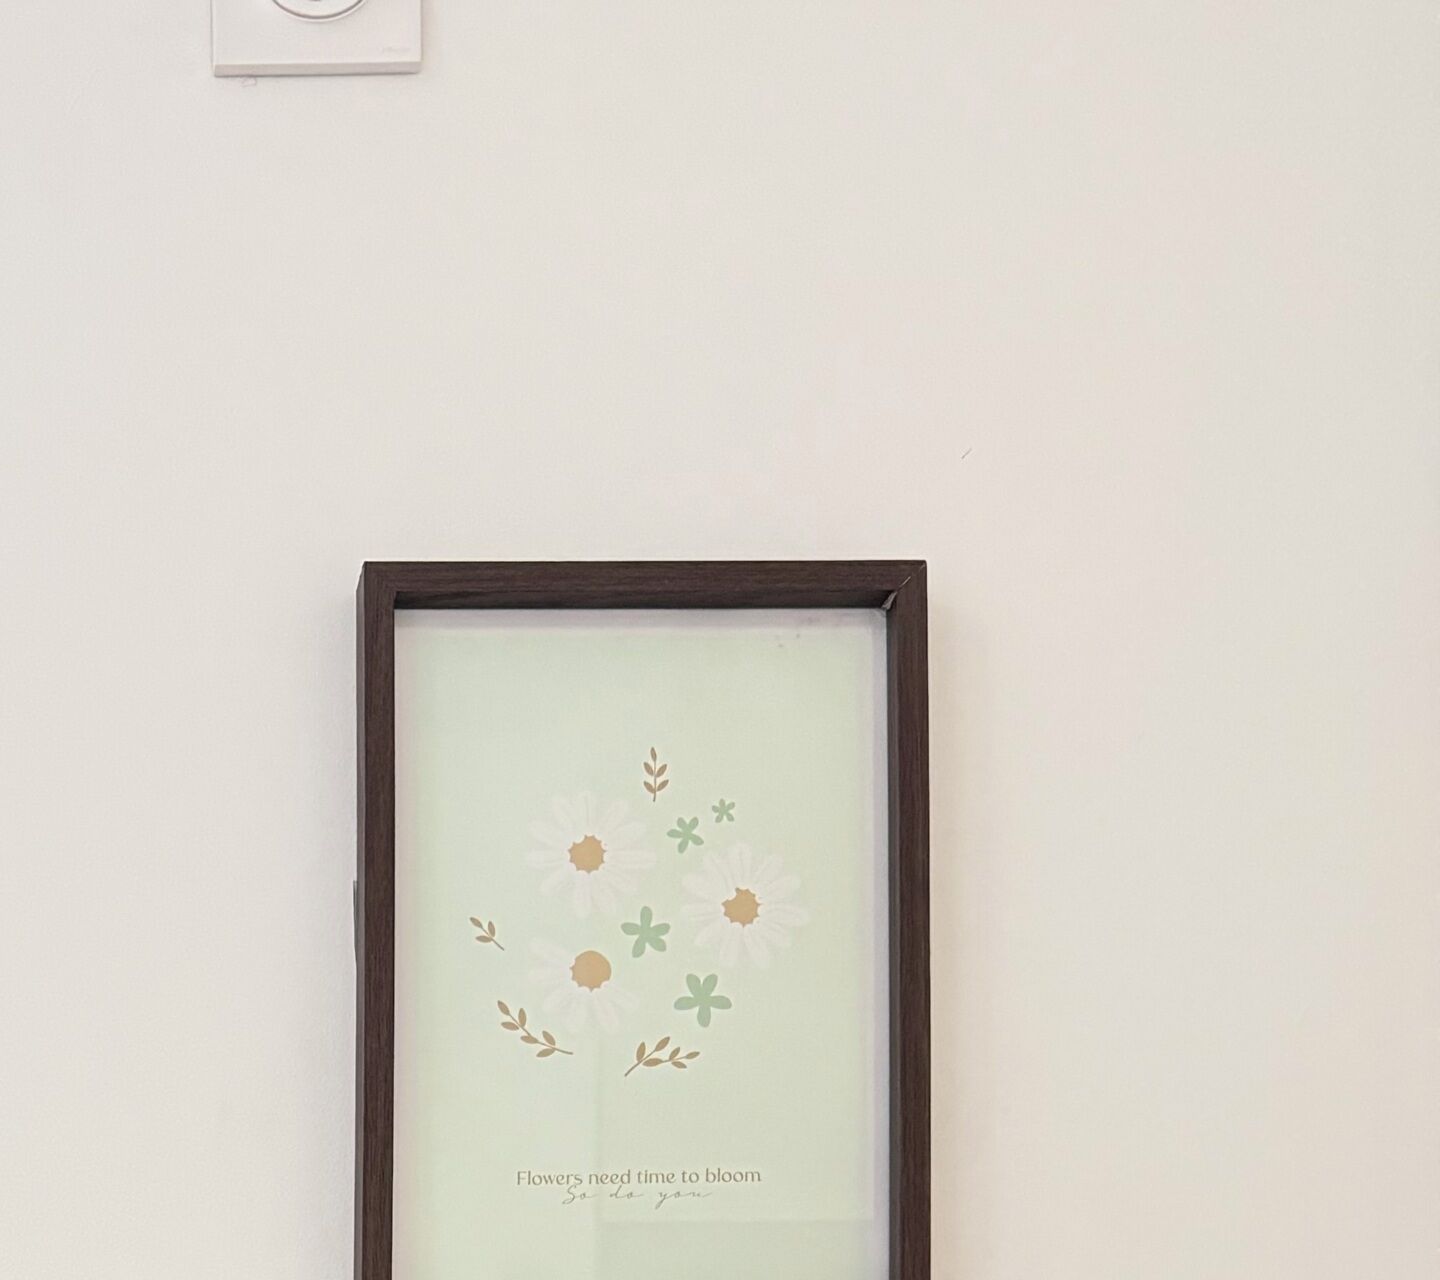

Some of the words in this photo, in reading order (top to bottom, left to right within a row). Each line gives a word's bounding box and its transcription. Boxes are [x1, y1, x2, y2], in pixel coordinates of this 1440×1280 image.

[516, 1170, 583, 1186] Flowers
[588, 1169, 631, 1185] need
[636, 1169, 677, 1184] time
[681, 1169, 700, 1184] to
[705, 1167, 762, 1183] bloom
